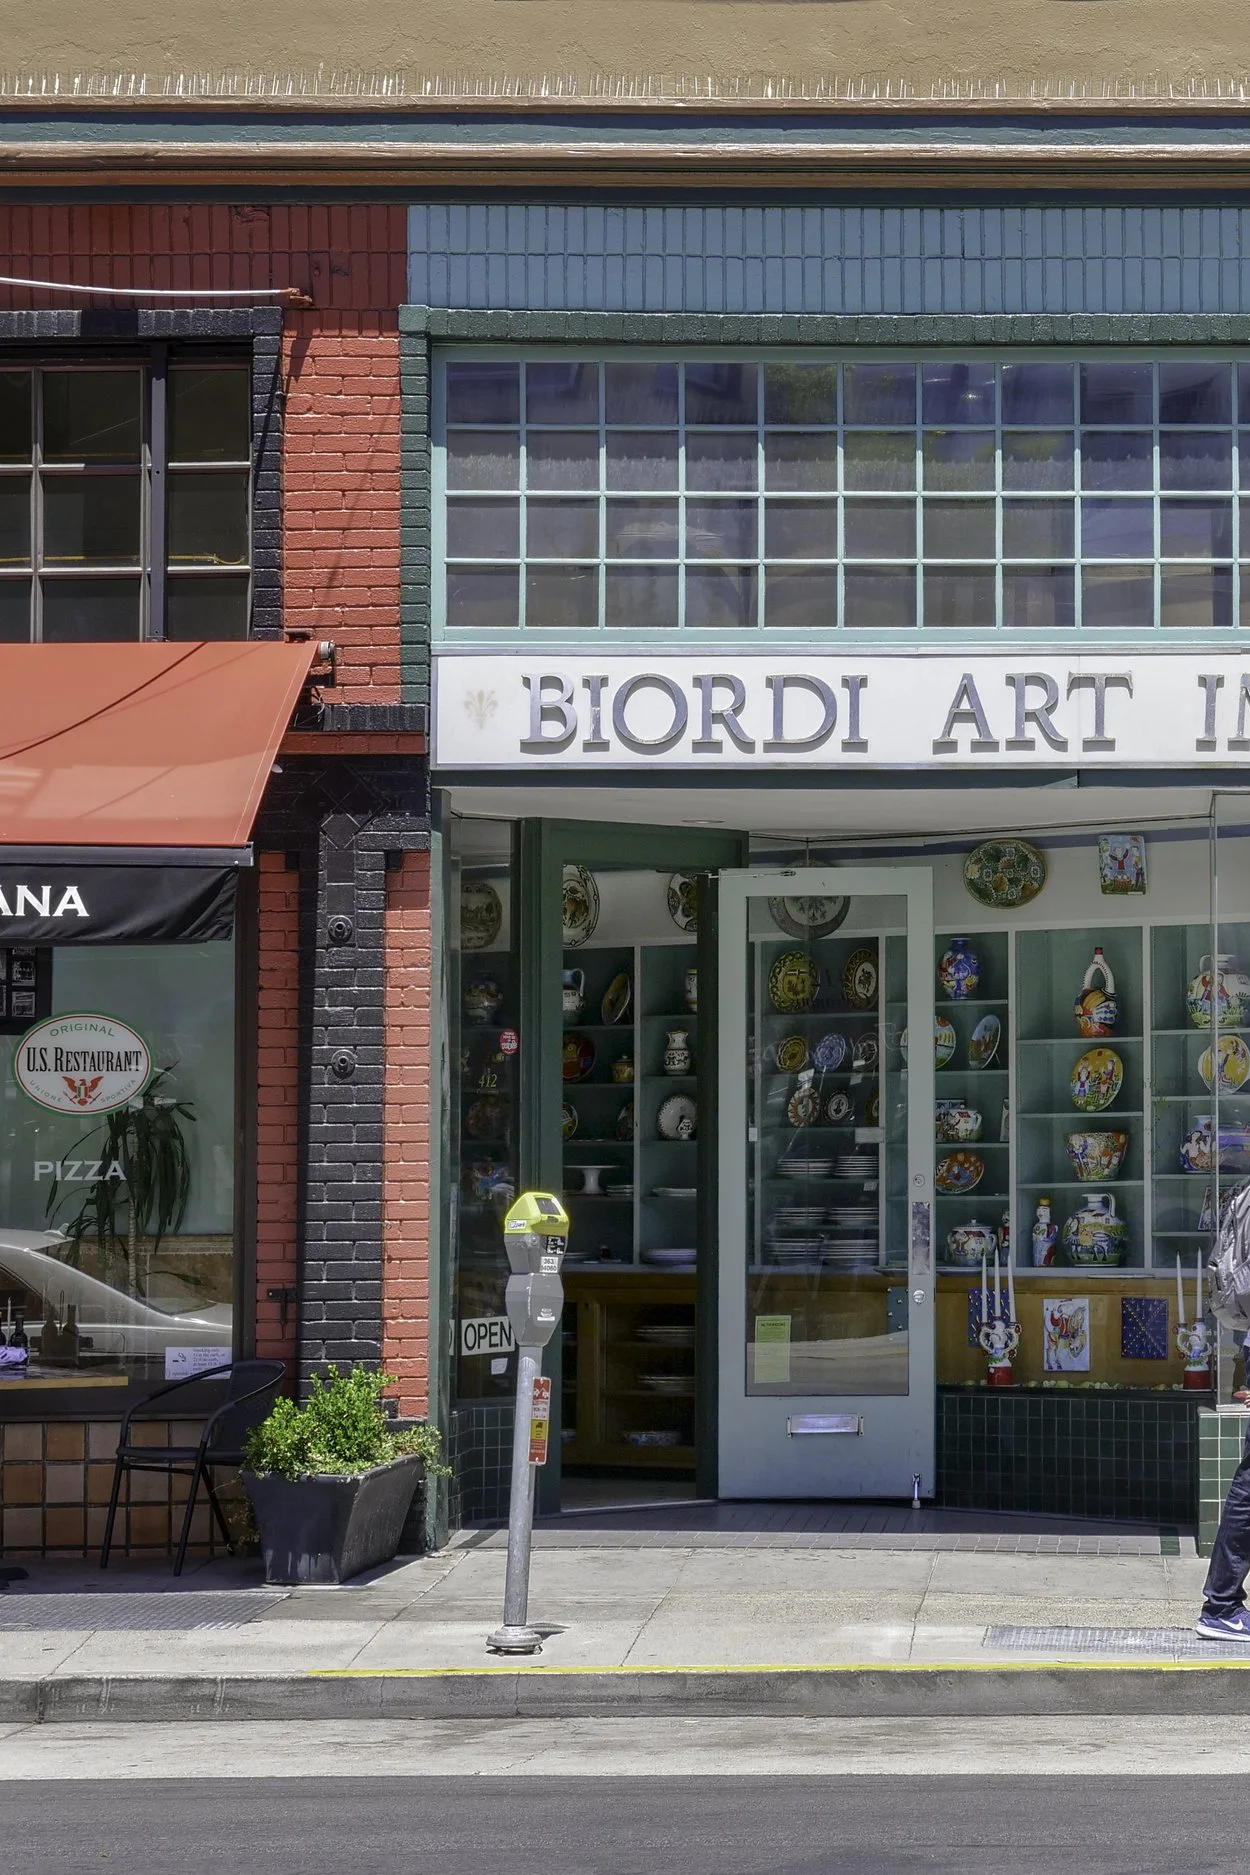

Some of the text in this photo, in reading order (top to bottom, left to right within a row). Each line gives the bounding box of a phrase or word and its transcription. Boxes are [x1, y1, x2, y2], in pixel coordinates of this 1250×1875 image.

[520, 672, 869, 748] BIORDI
[933, 671, 1134, 748] ART
[49, 1023, 115, 1038] ORIGINAL
[26, 1047, 142, 1073] U.S. RESTAURANT
[29, 1079, 63, 1104] UNIONE
[33, 1159, 128, 1181] PIZZA
[464, 1320, 512, 1351] OPEN
